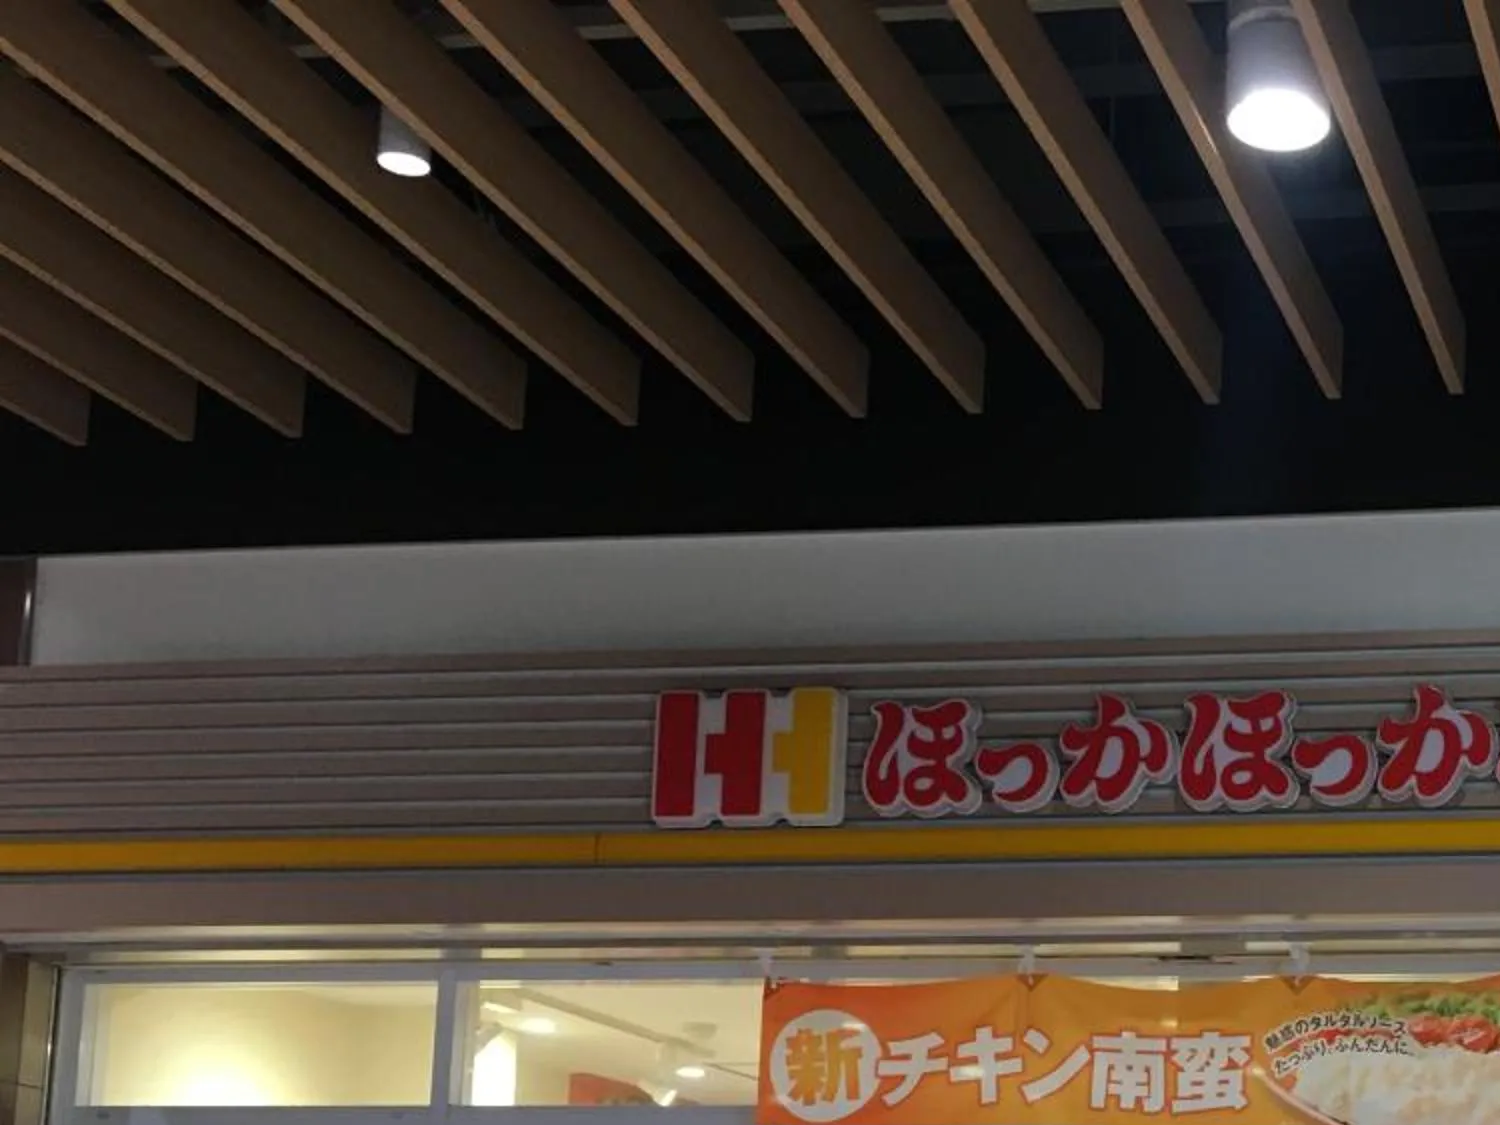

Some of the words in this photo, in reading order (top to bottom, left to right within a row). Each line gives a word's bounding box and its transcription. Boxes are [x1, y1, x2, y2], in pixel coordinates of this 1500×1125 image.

[878, 1028, 1252, 1112] チキン南蛮
